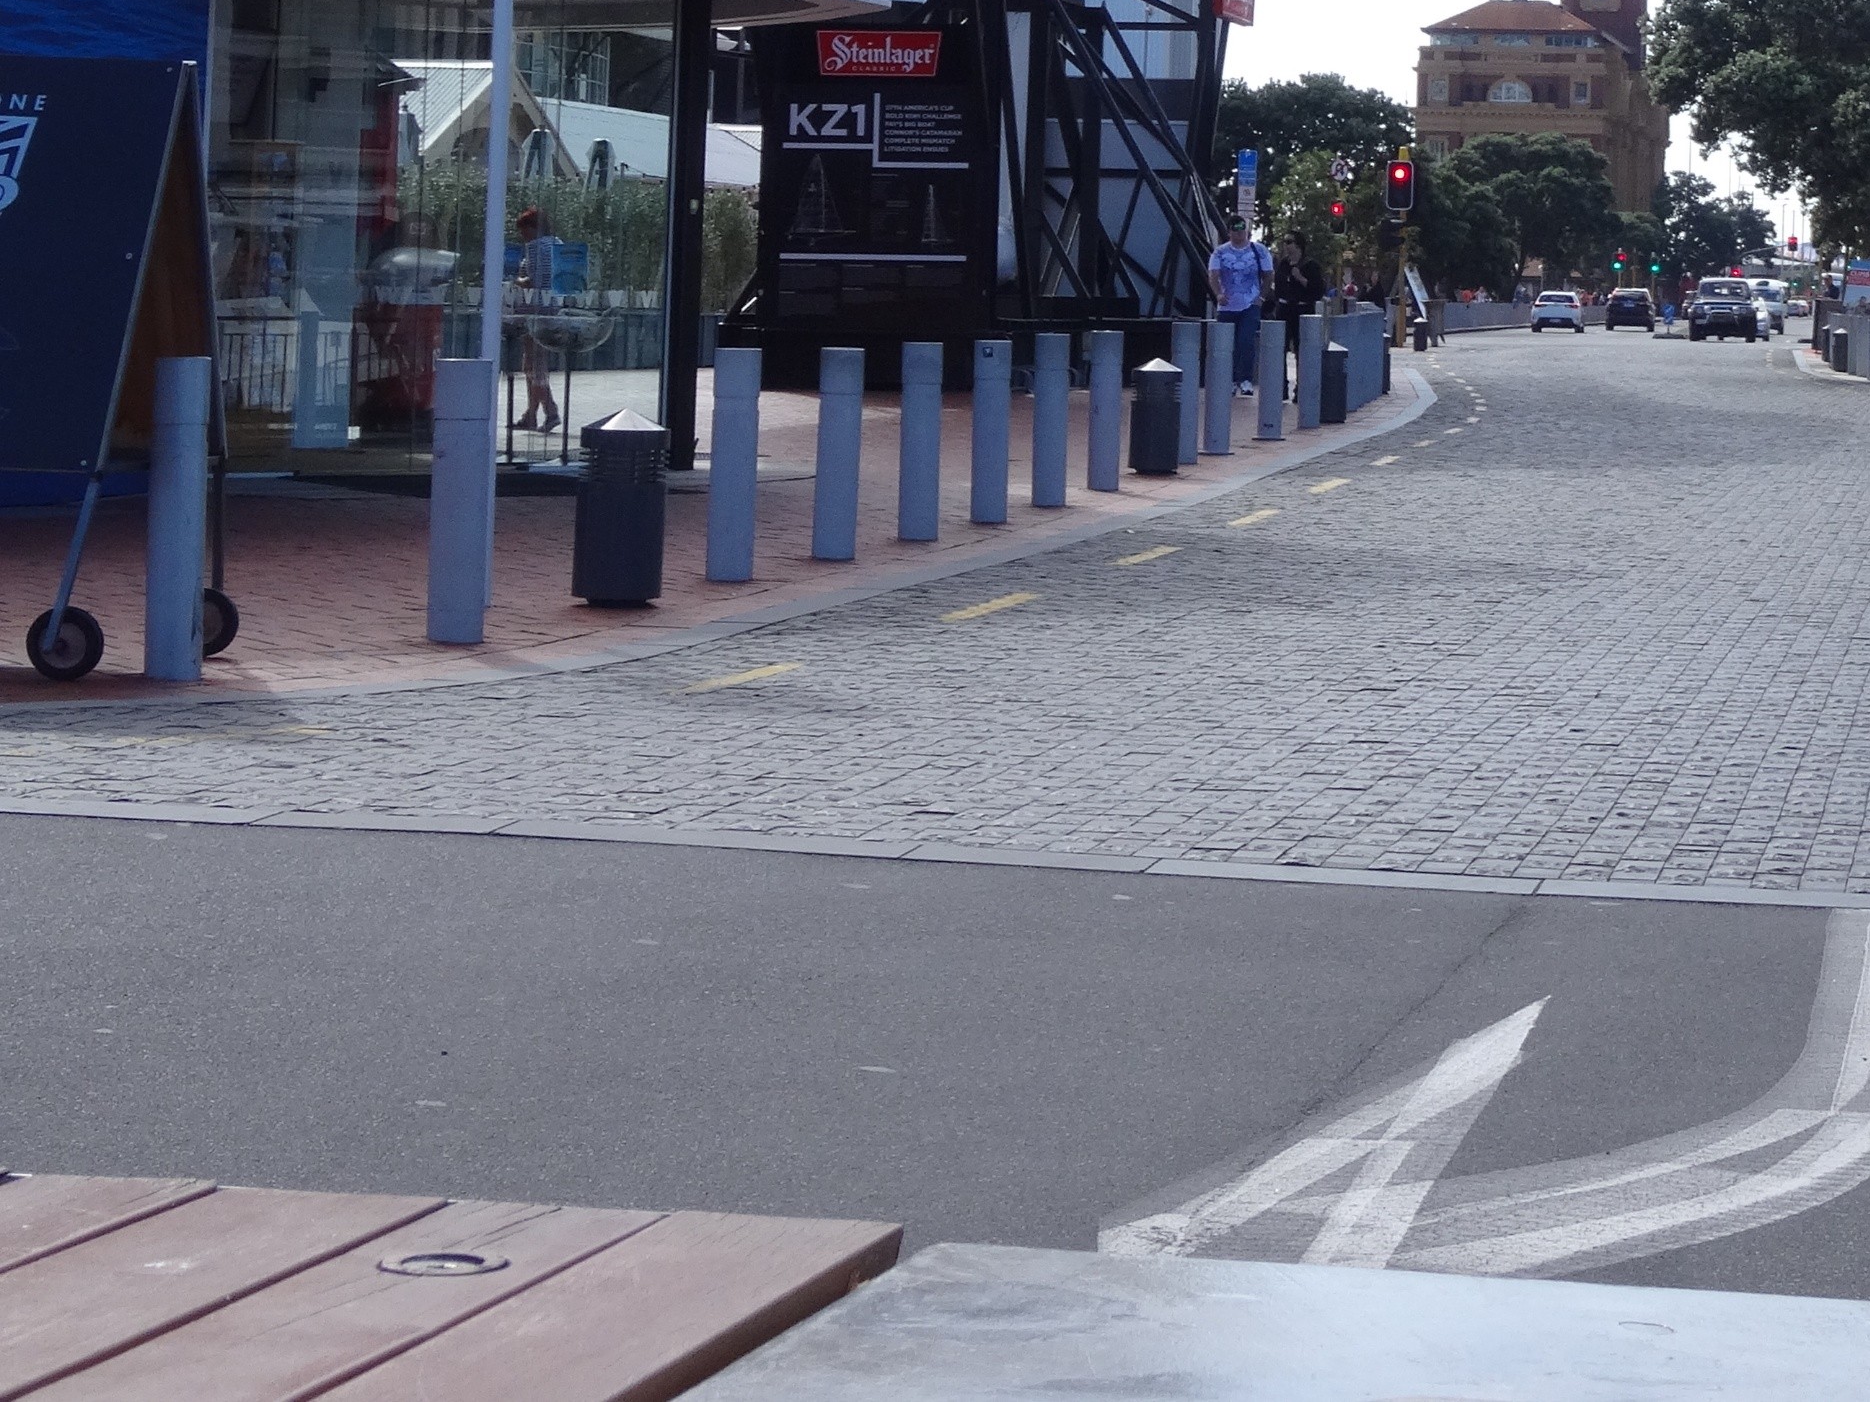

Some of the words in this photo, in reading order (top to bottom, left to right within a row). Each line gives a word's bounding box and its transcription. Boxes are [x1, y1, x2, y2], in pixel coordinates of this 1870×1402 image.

[824, 34, 935, 72] Steinlager
[0, 93, 47, 110] NE
[789, 103, 866, 136] KZ1
